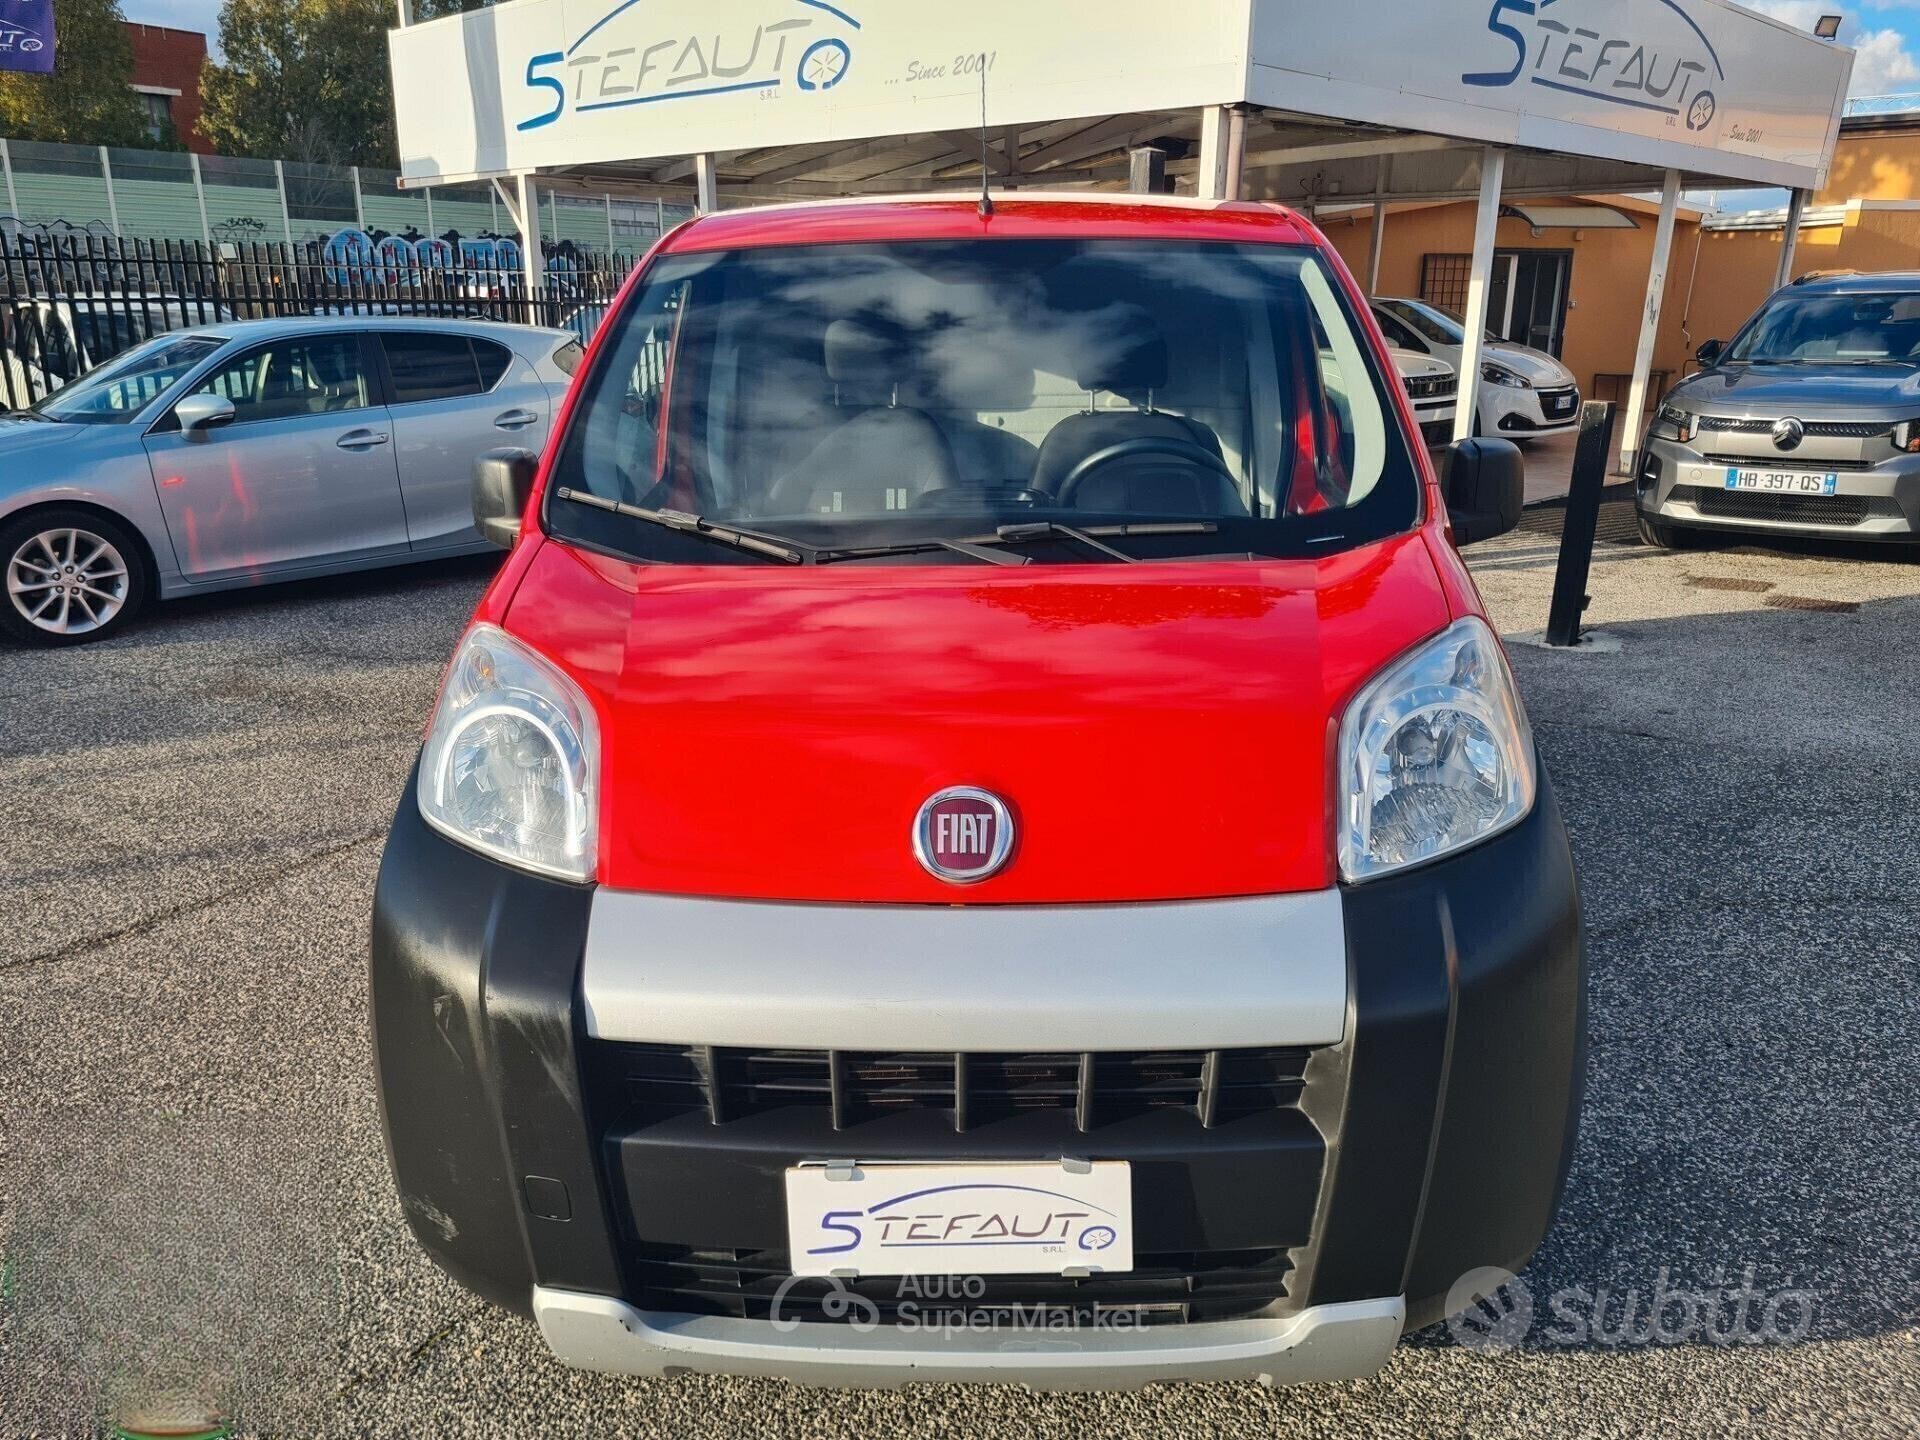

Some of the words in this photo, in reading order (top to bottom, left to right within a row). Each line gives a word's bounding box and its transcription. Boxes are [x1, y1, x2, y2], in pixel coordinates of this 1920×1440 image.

[905, 60, 947, 82] Since
[952, 50, 997, 76] 2001
[1738, 471, 1822, 492] HB-397-QS
[937, 813, 993, 854] FIAT
[807, 1211, 1117, 1256] STEFAUTO
